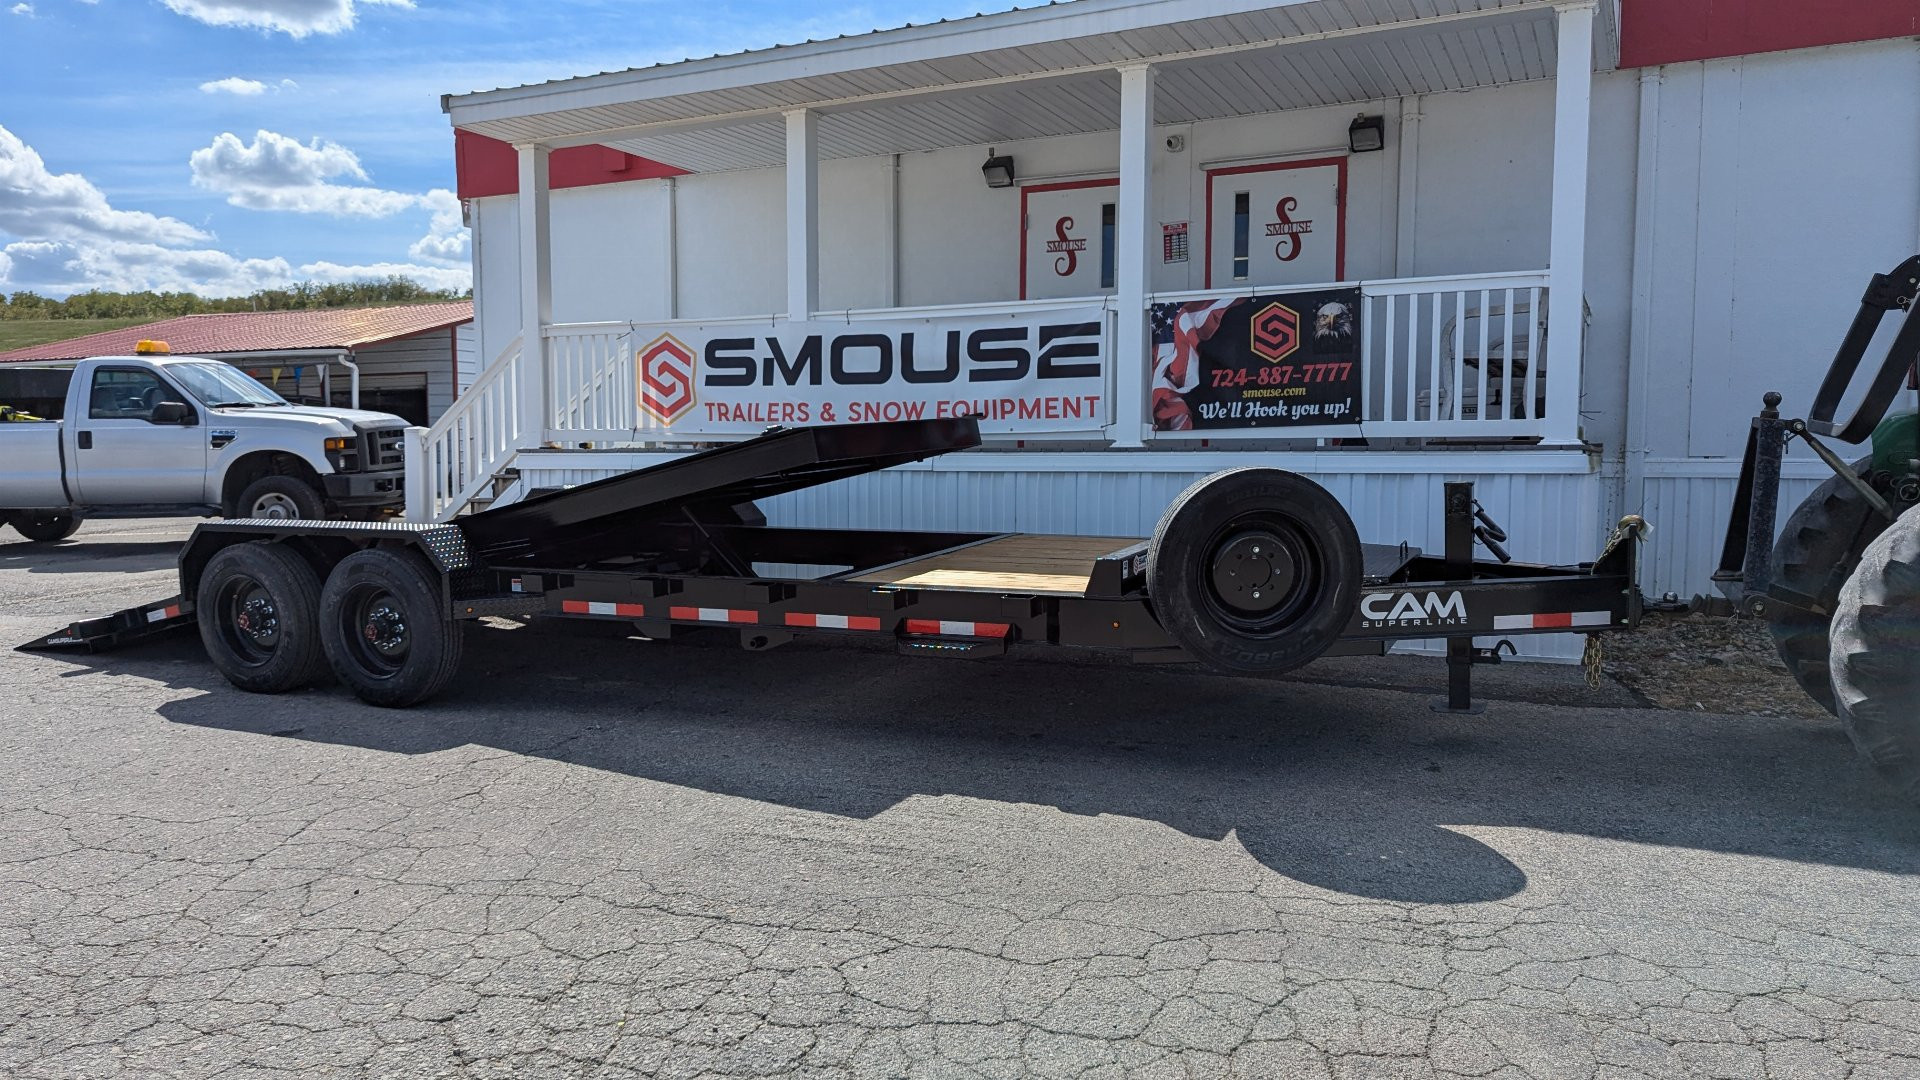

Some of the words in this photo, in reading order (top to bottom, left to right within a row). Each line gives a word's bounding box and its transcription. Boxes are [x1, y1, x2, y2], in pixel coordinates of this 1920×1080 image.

[1265, 220, 1312, 236] SMOUSE
[1047, 239, 1087, 252] SMOUSE
[704, 321, 1101, 387] SMOUSE
[1211, 362, 1353, 388] 724-887-7777
[1241, 387, 1307, 399] smouse.com
[704, 402, 810, 422] TRAILERS
[819, 402, 836, 422] &
[847, 400, 927, 422] SNOW
[936, 395, 1101, 421] EQUIPMENT
[1198, 400, 1242, 419] We'll
[1245, 400, 1288, 418] Hook
[1291, 402, 1320, 420] you
[1323, 397, 1352, 418] up!
[1360, 590, 1468, 620] CAM
[1362, 617, 1468, 628] SUPERLINE
